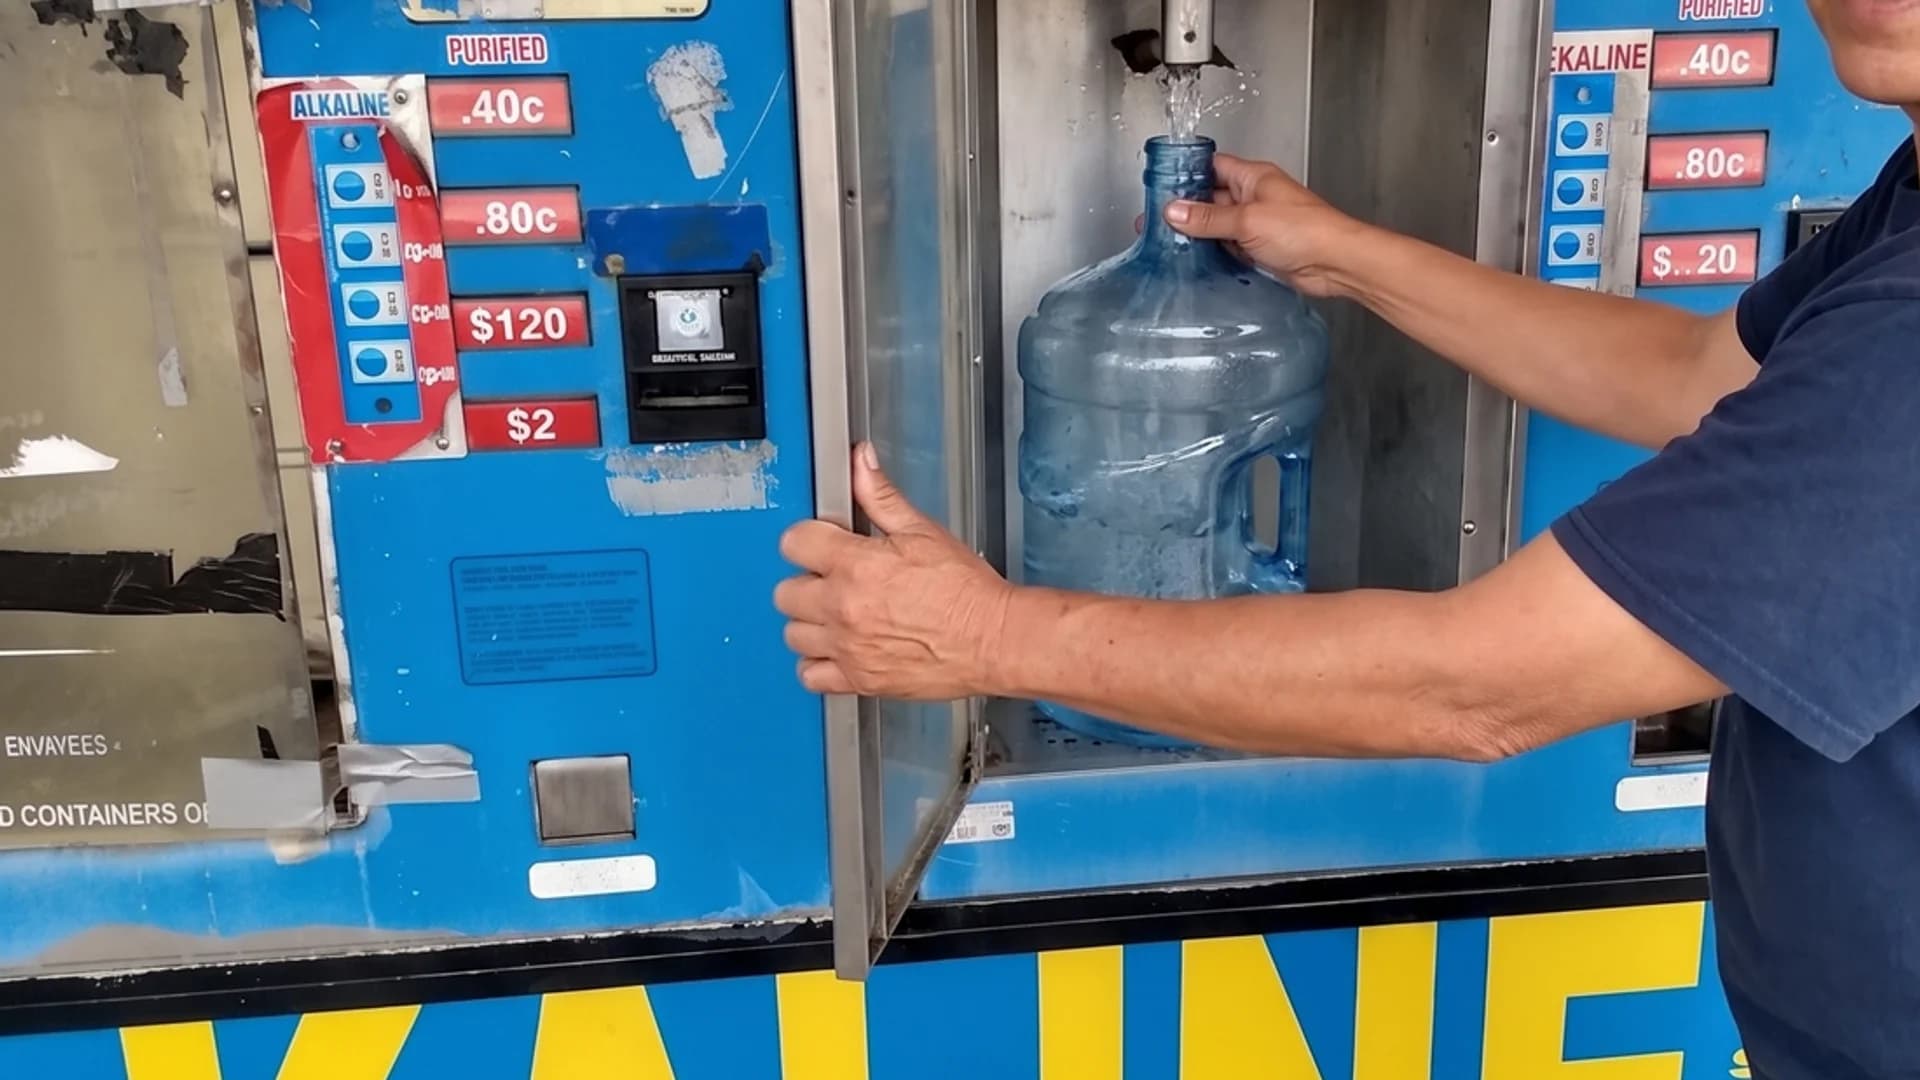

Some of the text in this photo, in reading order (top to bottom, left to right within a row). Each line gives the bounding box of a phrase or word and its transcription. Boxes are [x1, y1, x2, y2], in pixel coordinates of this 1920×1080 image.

[1681, 0, 1763, 18] PURIFIED
[447, 35, 547, 65] PURIFIED
[1680, 44, 1750, 76] .40c
[292, 93, 391, 118] ALKALINE
[461, 89, 545, 125] .40c
[1675, 148, 1745, 179] .80c
[475, 202, 558, 235] .80c
[470, 307, 567, 343] $120
[506, 408, 556, 445] $2
[20, 803, 178, 827] CONTAINERS
